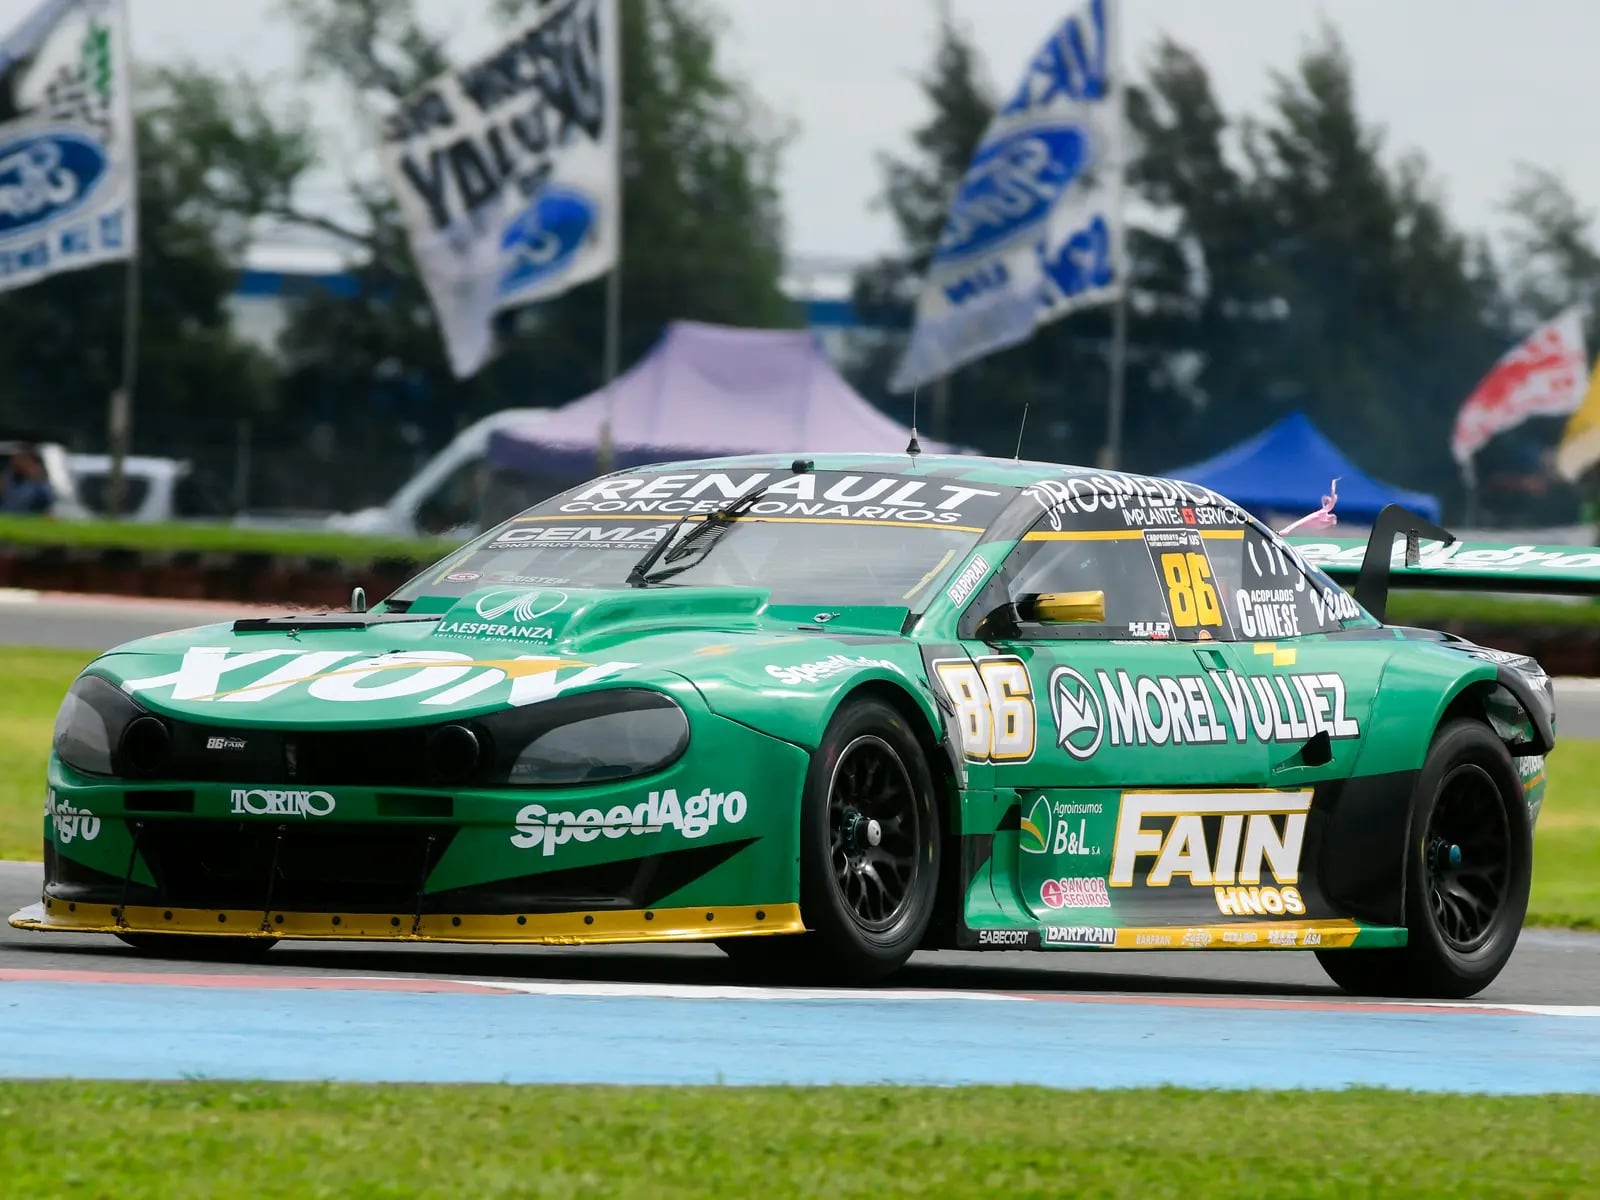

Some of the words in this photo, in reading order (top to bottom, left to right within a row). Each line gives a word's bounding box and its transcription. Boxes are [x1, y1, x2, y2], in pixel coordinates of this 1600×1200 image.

[573, 472, 1001, 512] RENAULT
[558, 499, 964, 524] CONCESIONARIOS
[488, 542, 610, 550] CONSTRUCTORA
[949, 555, 988, 606] BARPRAN
[1161, 552, 1223, 627] 86
[1250, 589, 1295, 603] ACOPLADOS
[1236, 588, 1302, 638] CONESE
[122, 646, 640, 707] XION
[935, 656, 1035, 765] 86
[1097, 669, 1229, 746] MOREL
[1208, 668, 1361, 745] VULLIEZ
[206, 738, 224, 749] 86
[231, 789, 336, 820] TORINO
[1053, 801, 1103, 817] Agroinsumos
[510, 787, 748, 857] SpeedAgro
[1053, 819, 1090, 855] B&L
[1109, 789, 1315, 888] FAIN
[1060, 879, 1106, 894] SANCOR
[1064, 893, 1110, 906] SEGUROS
[1214, 887, 1307, 915] HNOS
[979, 930, 1029, 945] SABECORT
[1048, 927, 1115, 942] BARPRAN
